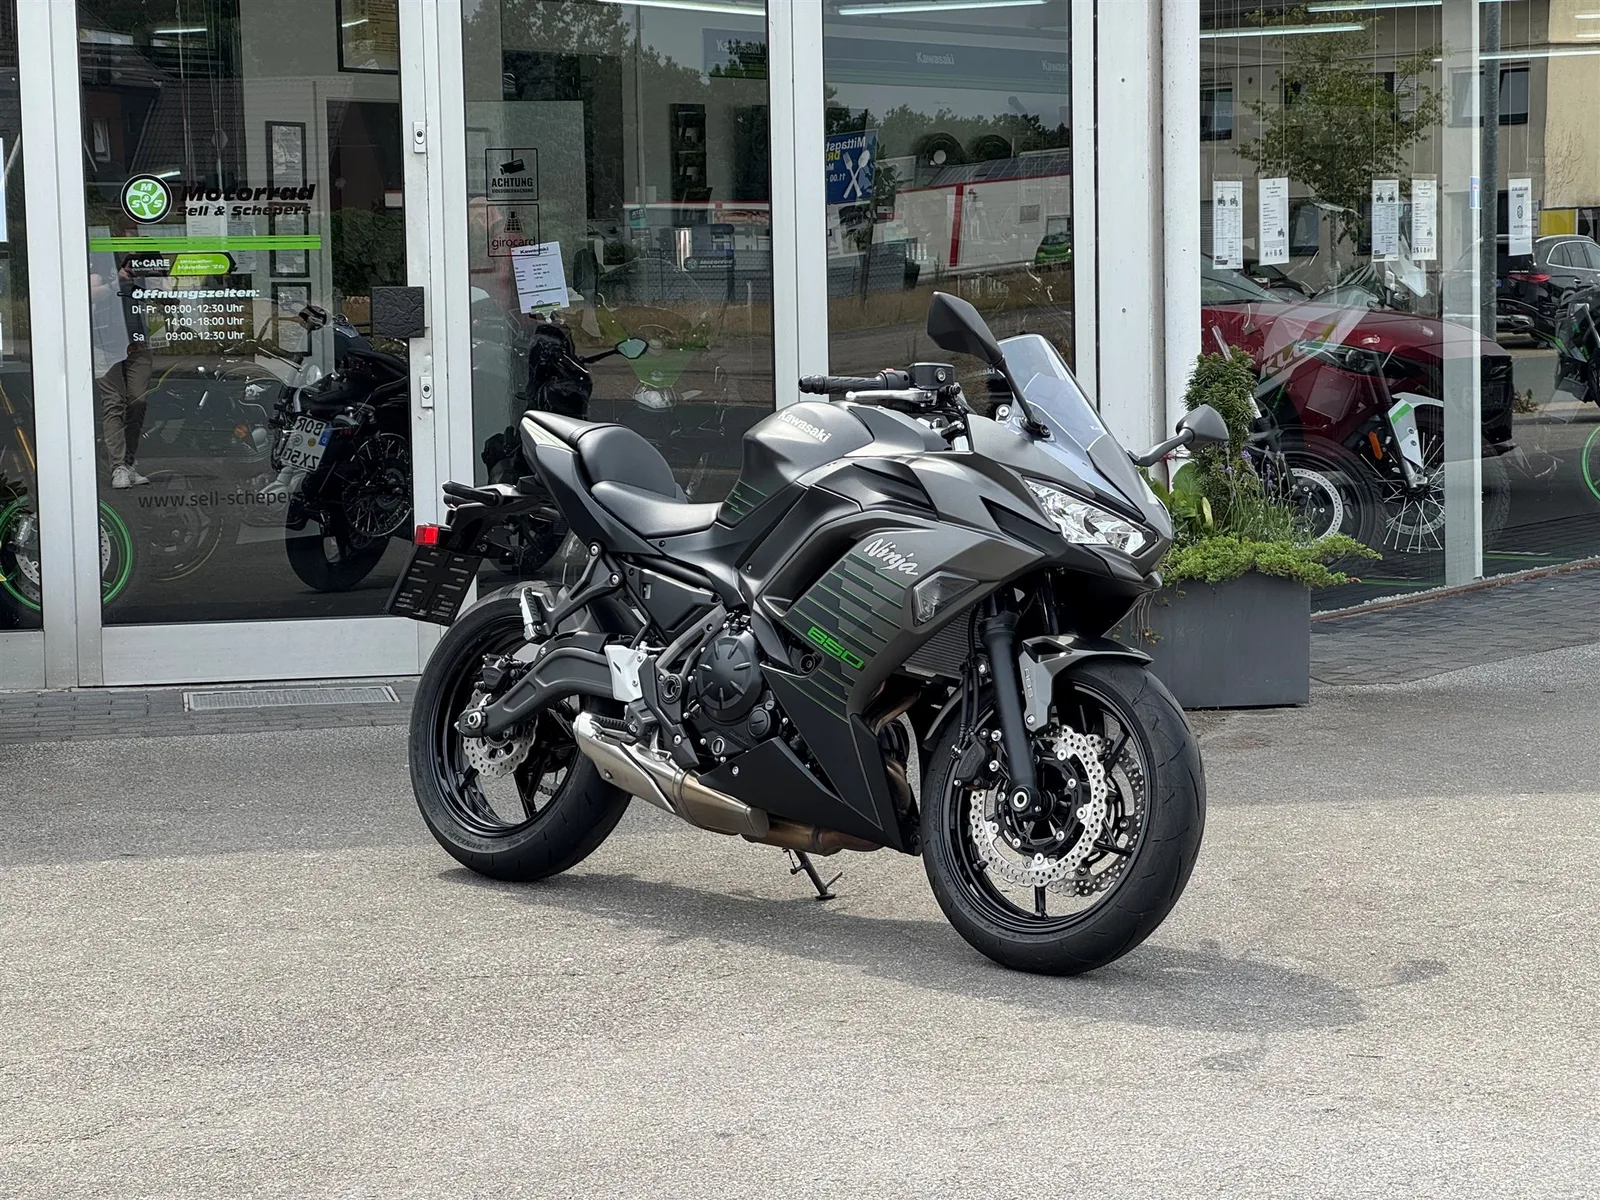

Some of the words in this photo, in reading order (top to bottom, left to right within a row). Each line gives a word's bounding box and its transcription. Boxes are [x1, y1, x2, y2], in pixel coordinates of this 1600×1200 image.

[916, 52, 954, 65] Kawasaki
[140, 183, 152, 191] M
[491, 177, 533, 187] ACHTUNG
[181, 184, 316, 201] Motorrad
[132, 200, 141, 208] S
[153, 199, 163, 207] S
[176, 206, 208, 217] Sell
[214, 206, 226, 216] &
[231, 205, 312, 216] Schepers
[491, 236, 536, 250] girocard
[226, 303, 245, 313] Uhr
[226, 316, 245, 326] Uhr
[132, 332, 145, 341] Sa
[227, 331, 245, 340] Uhr
[777, 409, 833, 444] Kawasaki
[863, 537, 920, 577] Ninja
[807, 626, 865, 670] 650
